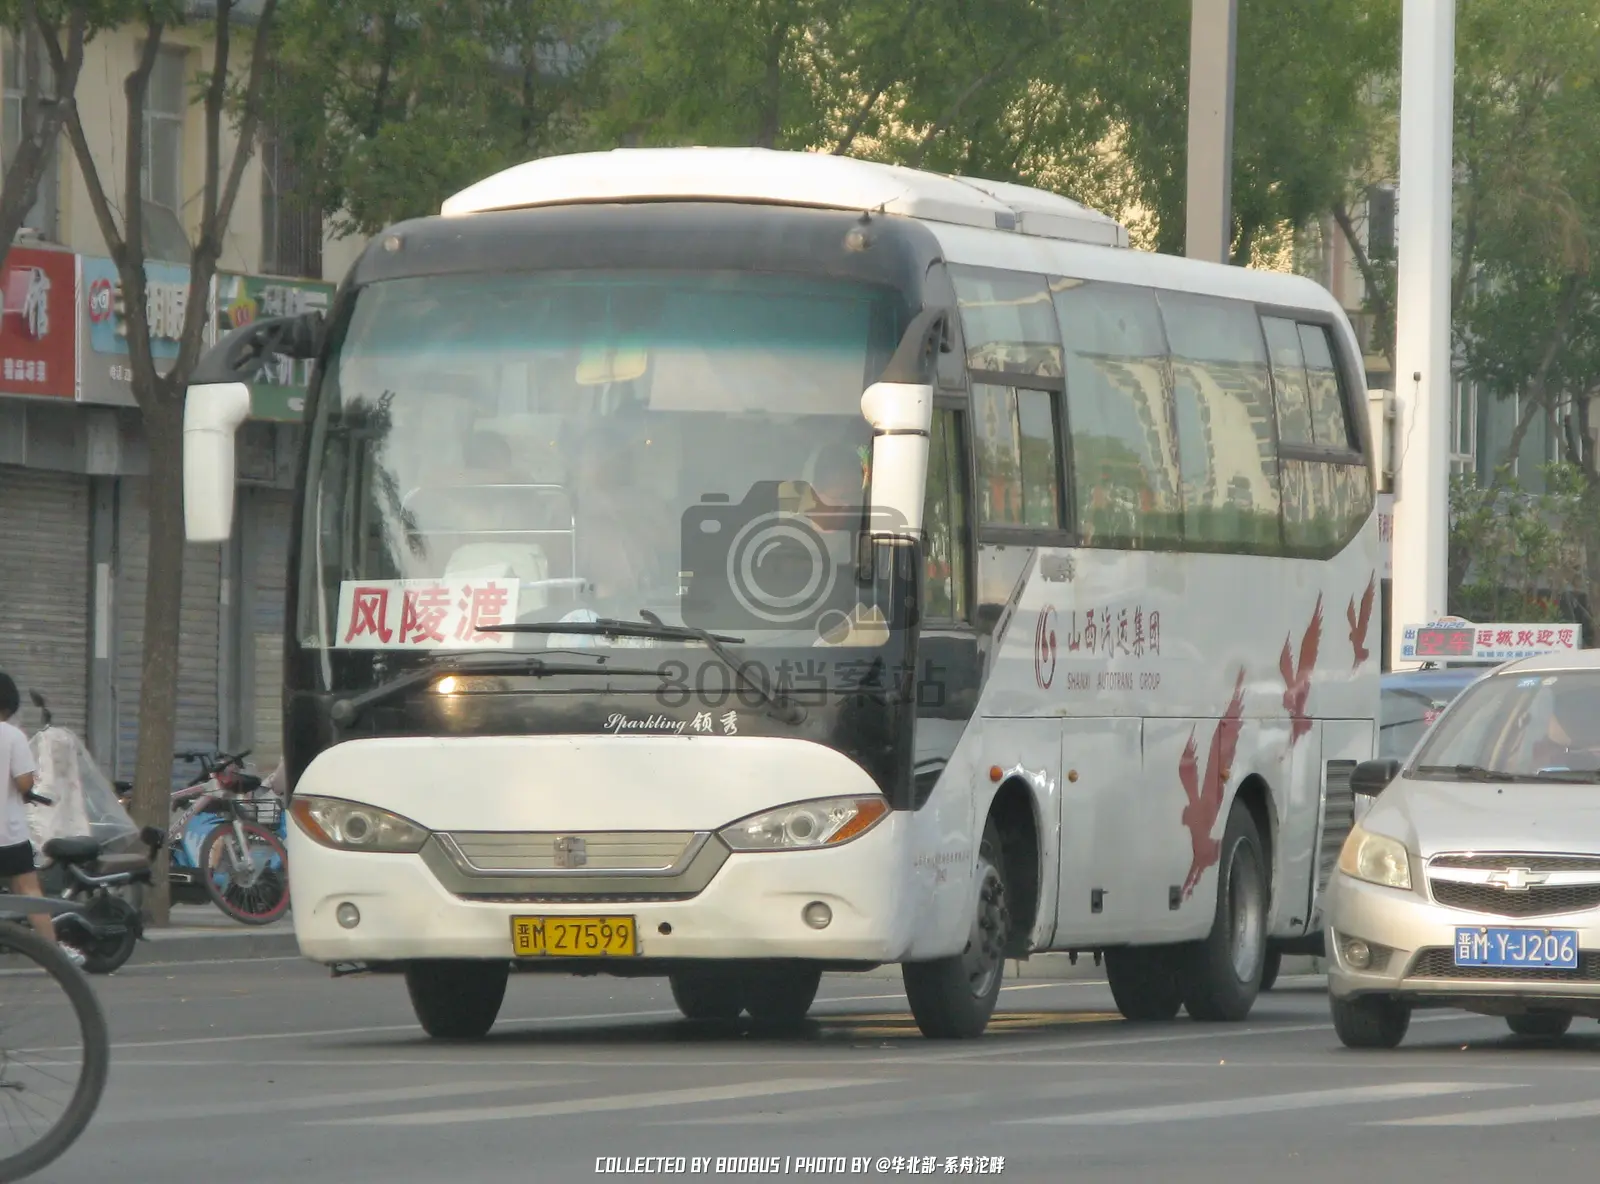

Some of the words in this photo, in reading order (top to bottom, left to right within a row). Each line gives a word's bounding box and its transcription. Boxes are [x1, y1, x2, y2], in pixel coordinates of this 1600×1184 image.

[345, 582, 508, 644] 风陵渡
[1068, 605, 1160, 659] 山西汽运集团
[1403, 629, 1416, 657] 出租
[1419, 630, 1472, 656] 空车
[1476, 628, 1575, 649] 运城欢迎您
[1097, 672, 1133, 690] AUTOTRANS
[1140, 672, 1161, 690] GROUP
[604, 713, 687, 734] Sparkling
[689, 711, 738, 735] 领秀
